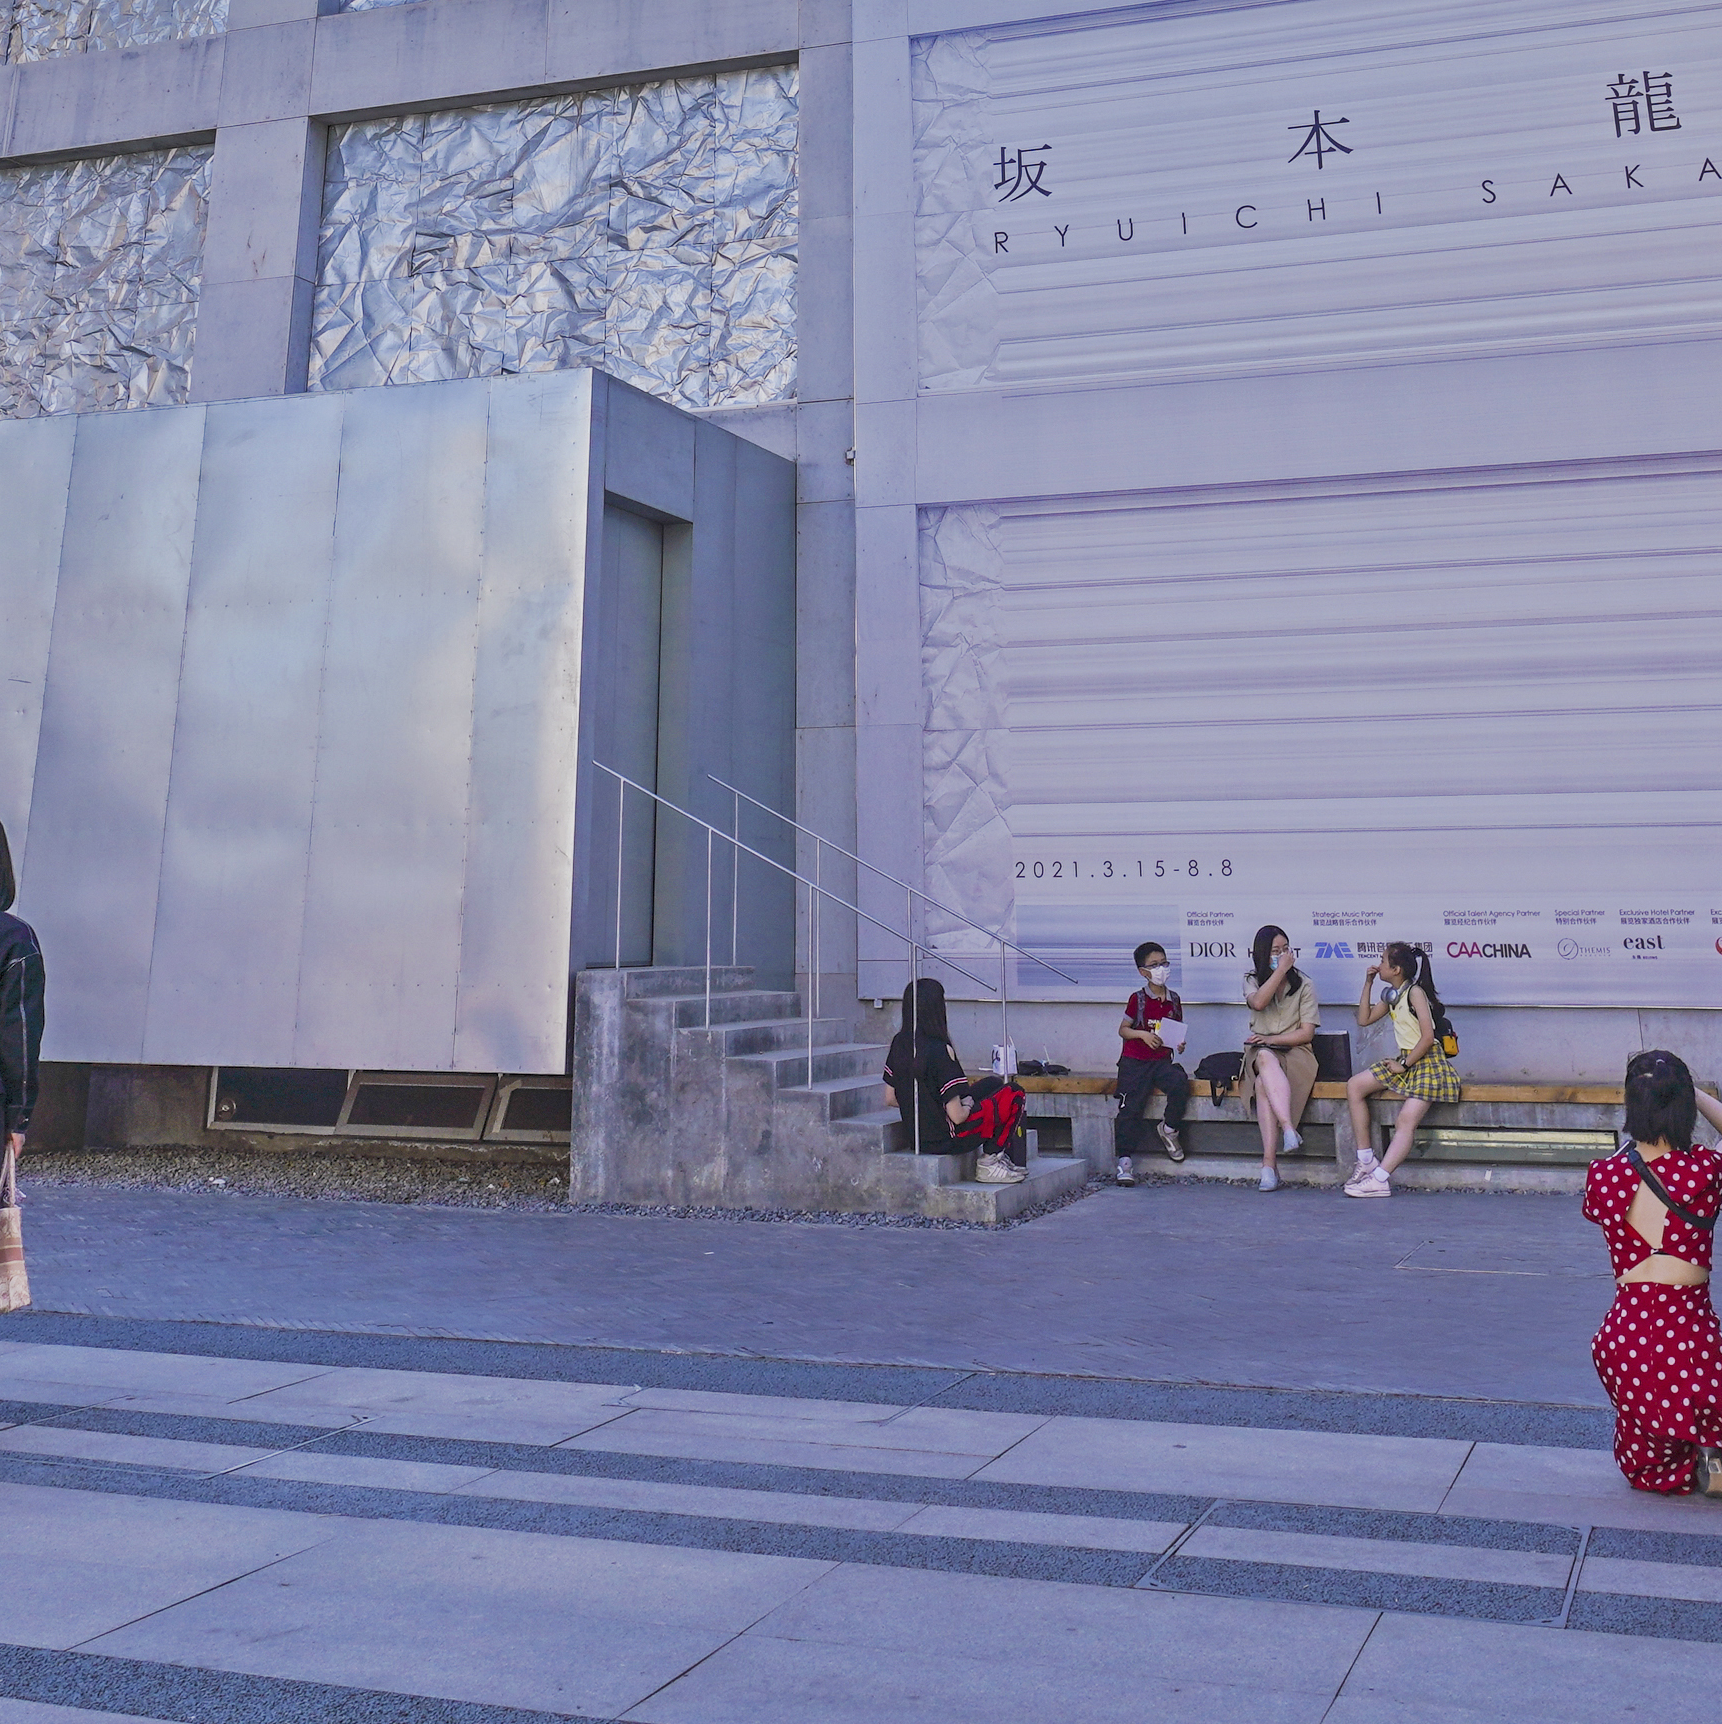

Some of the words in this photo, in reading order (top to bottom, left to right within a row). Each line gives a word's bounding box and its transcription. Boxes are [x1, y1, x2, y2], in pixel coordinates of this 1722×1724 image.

[994, 191, 1383, 254] RYUICHI
[1015, 859, 1233, 878] 2021.3.15-8.8
[1311, 911, 1340, 919] Strategic
[1489, 910, 1515, 918] Agency
[1516, 909, 1541, 917] Partner
[1554, 909, 1580, 917] Special
[1619, 908, 1649, 916] Exclusive
[1650, 908, 1669, 916] Hotel
[1670, 908, 1695, 916] Partner
[1623, 935, 1666, 950] east
[1189, 941, 1237, 958] DIOR
[1580, 946, 1611, 954] THEMIS
